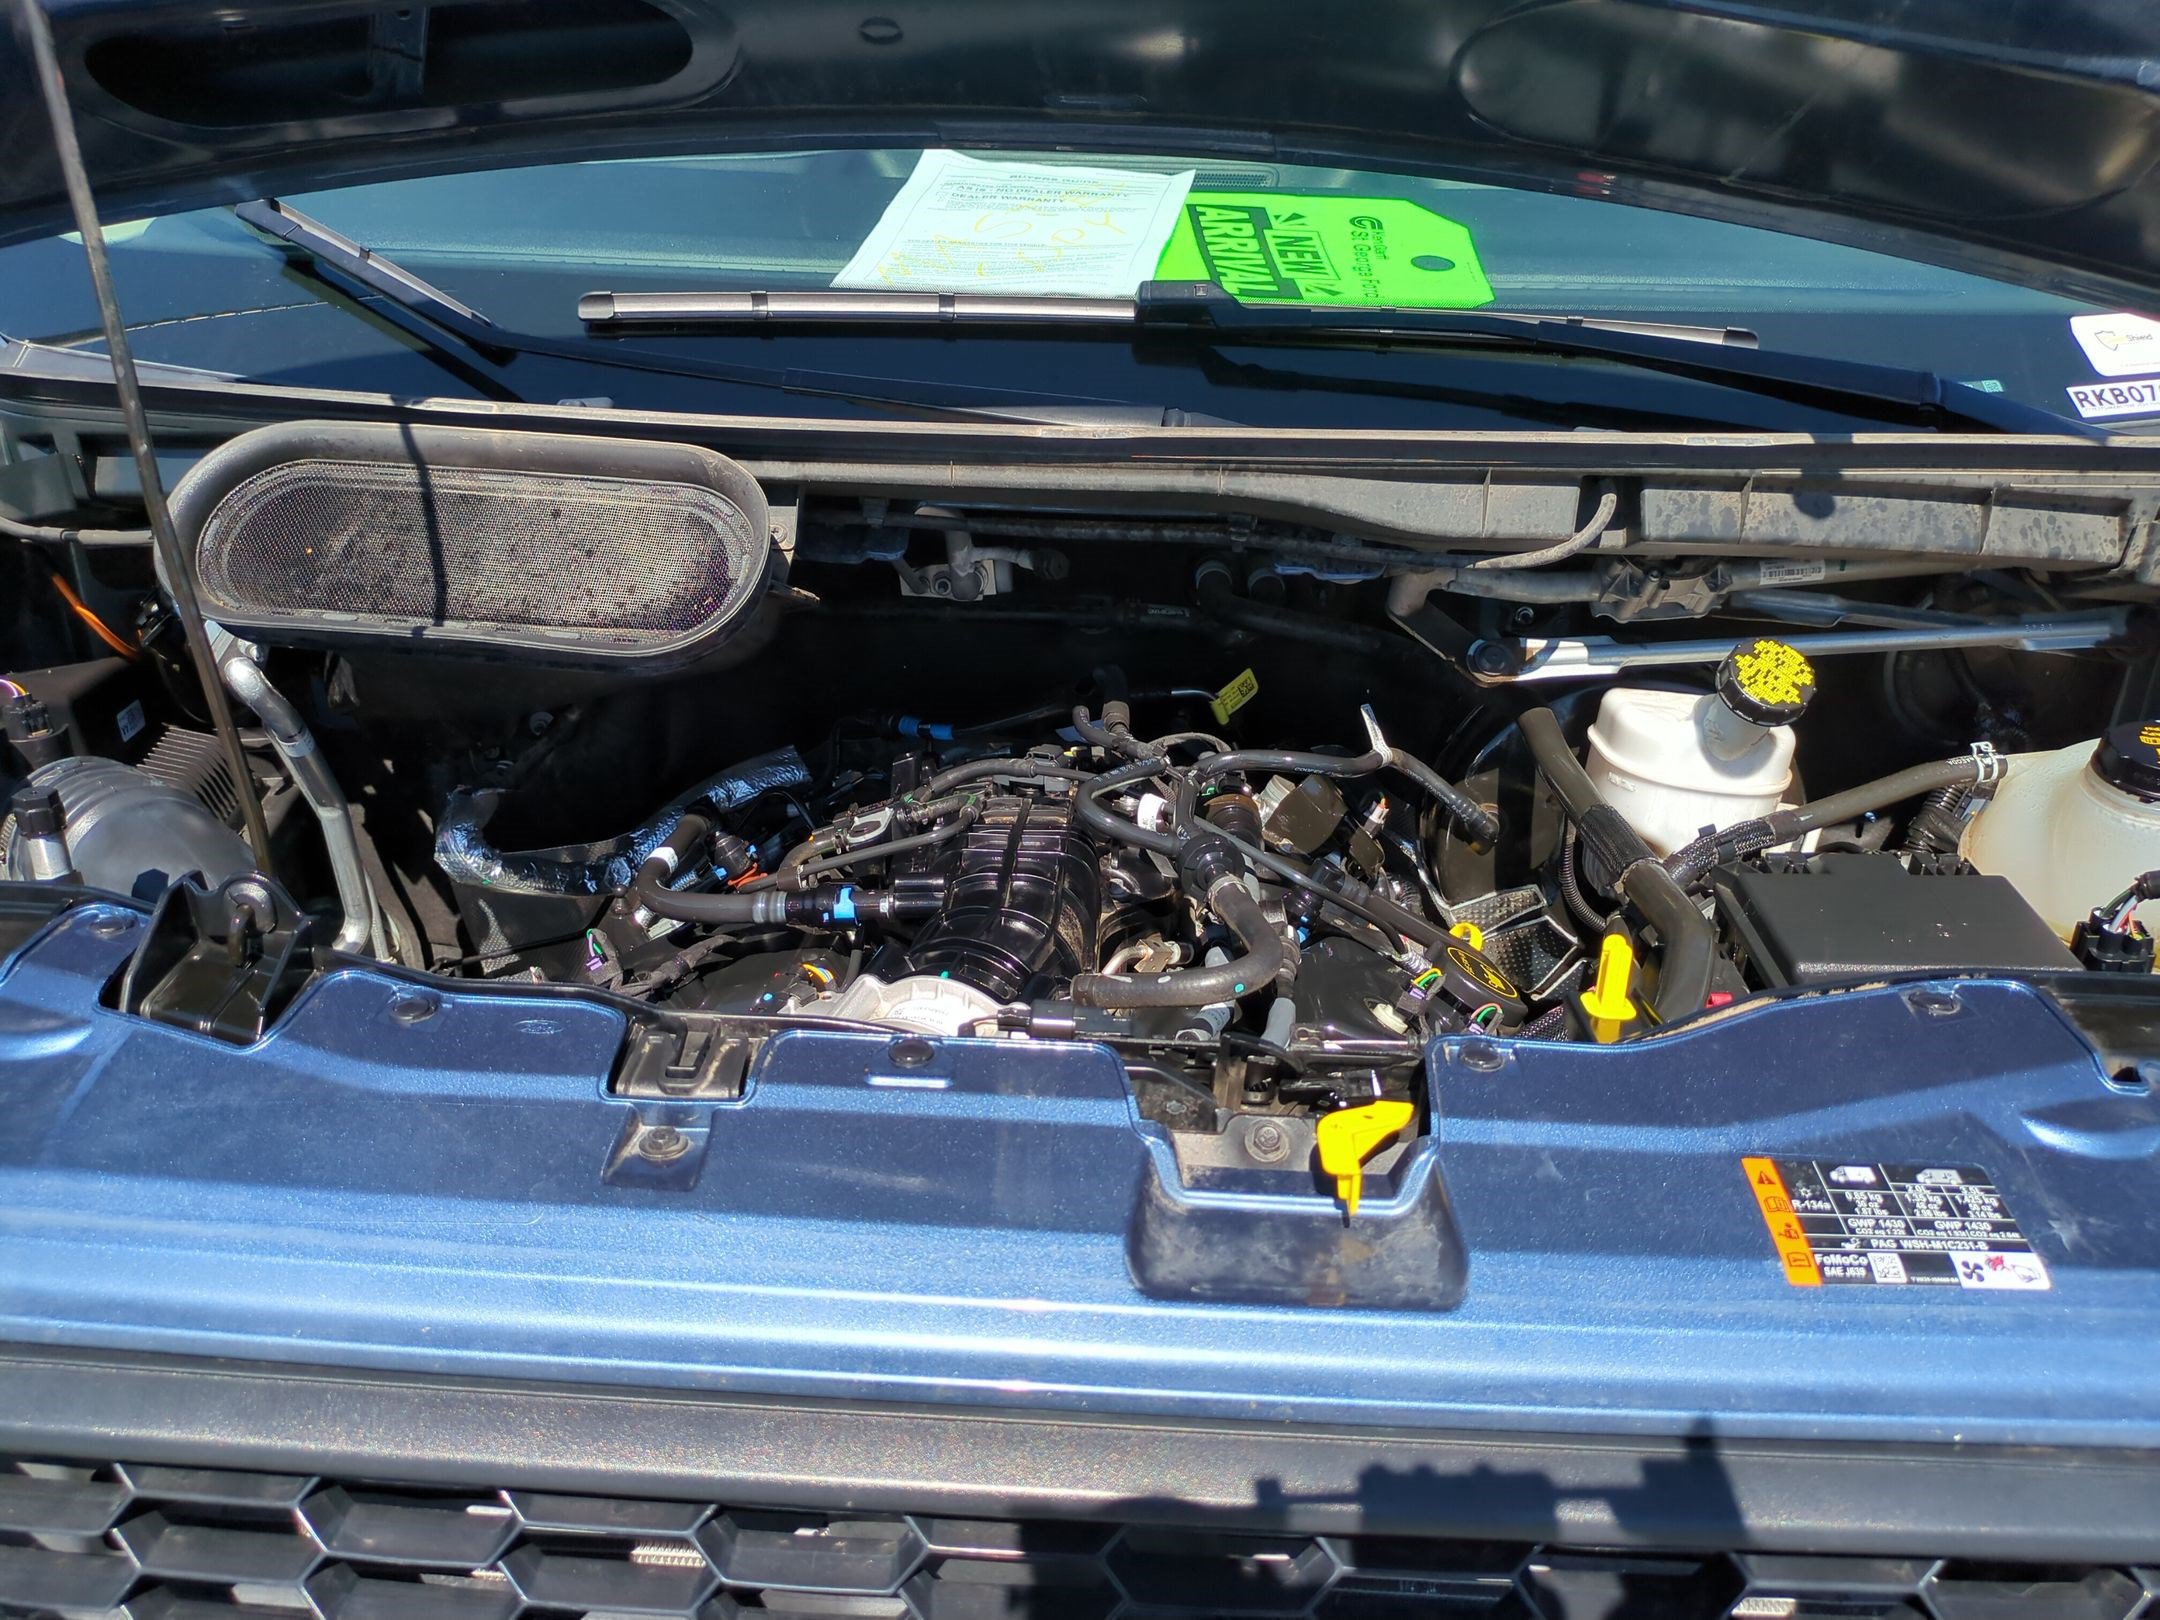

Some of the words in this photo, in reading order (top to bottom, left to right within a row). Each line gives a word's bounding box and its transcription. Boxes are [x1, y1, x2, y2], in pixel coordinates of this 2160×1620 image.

[1000, 195, 1066, 203] WARRANTY
[1196, 206, 1279, 297] ARRIVAL
[1271, 235, 1328, 277] NEW
[1352, 244, 1375, 277] George
[2073, 385, 2160, 408] RKB07
[1868, 1192, 1884, 1204] kg
[1929, 1195, 1943, 1206] kg
[1983, 1197, 1999, 1208] kg
[1791, 1199, 1831, 1211] R-134a
[1874, 1208, 1889, 1216] lbs
[1847, 1218, 1876, 1228] GWP
[1878, 1219, 1906, 1229] 1430
[1934, 1220, 1962, 1230] GWP
[1965, 1221, 1992, 1231] 1430
[1870, 1239, 1898, 1249] PAG
[1814, 1253, 1869, 1265] FoMoCo
[1823, 1266, 1844, 1277] SAE
